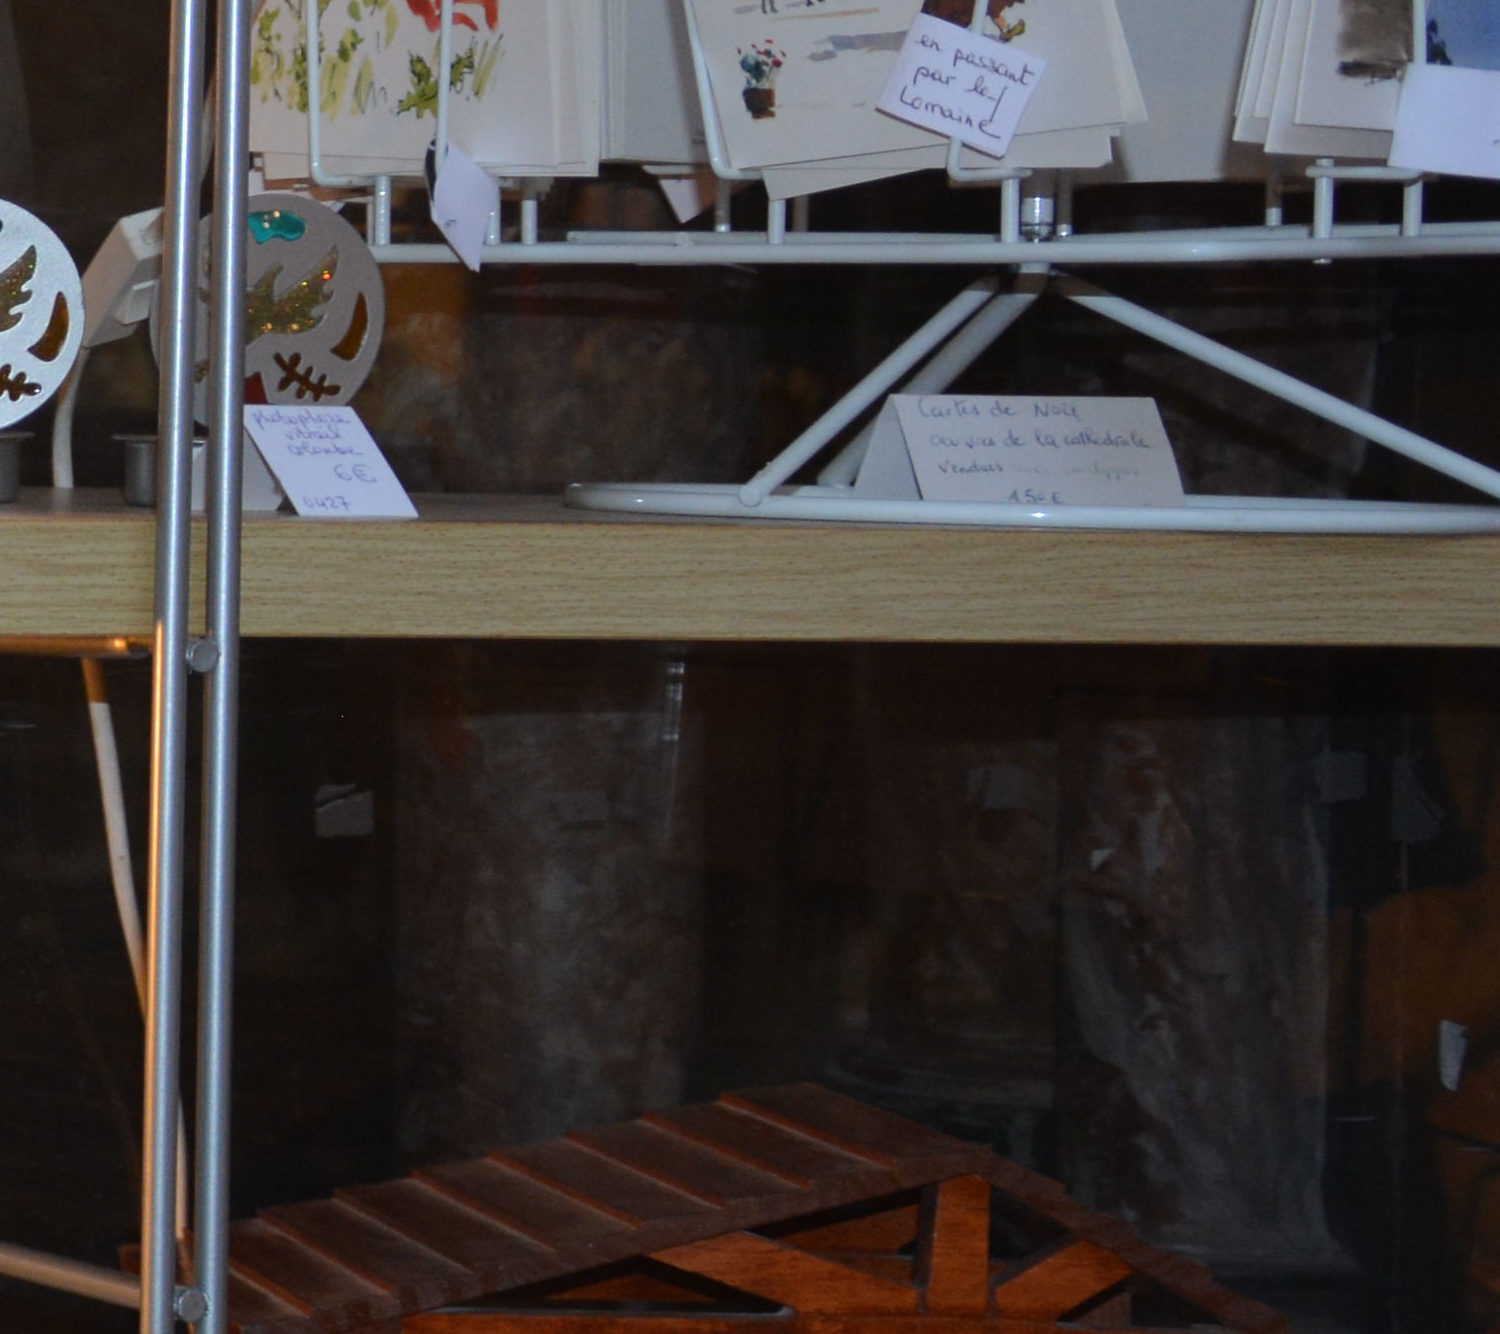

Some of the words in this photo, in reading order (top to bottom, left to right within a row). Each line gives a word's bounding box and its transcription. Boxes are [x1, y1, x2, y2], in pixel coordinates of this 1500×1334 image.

[915, 34, 942, 52] en
[953, 48, 1035, 86] passant
[913, 66, 957, 86] par
[303, 496, 352, 511] 0427
